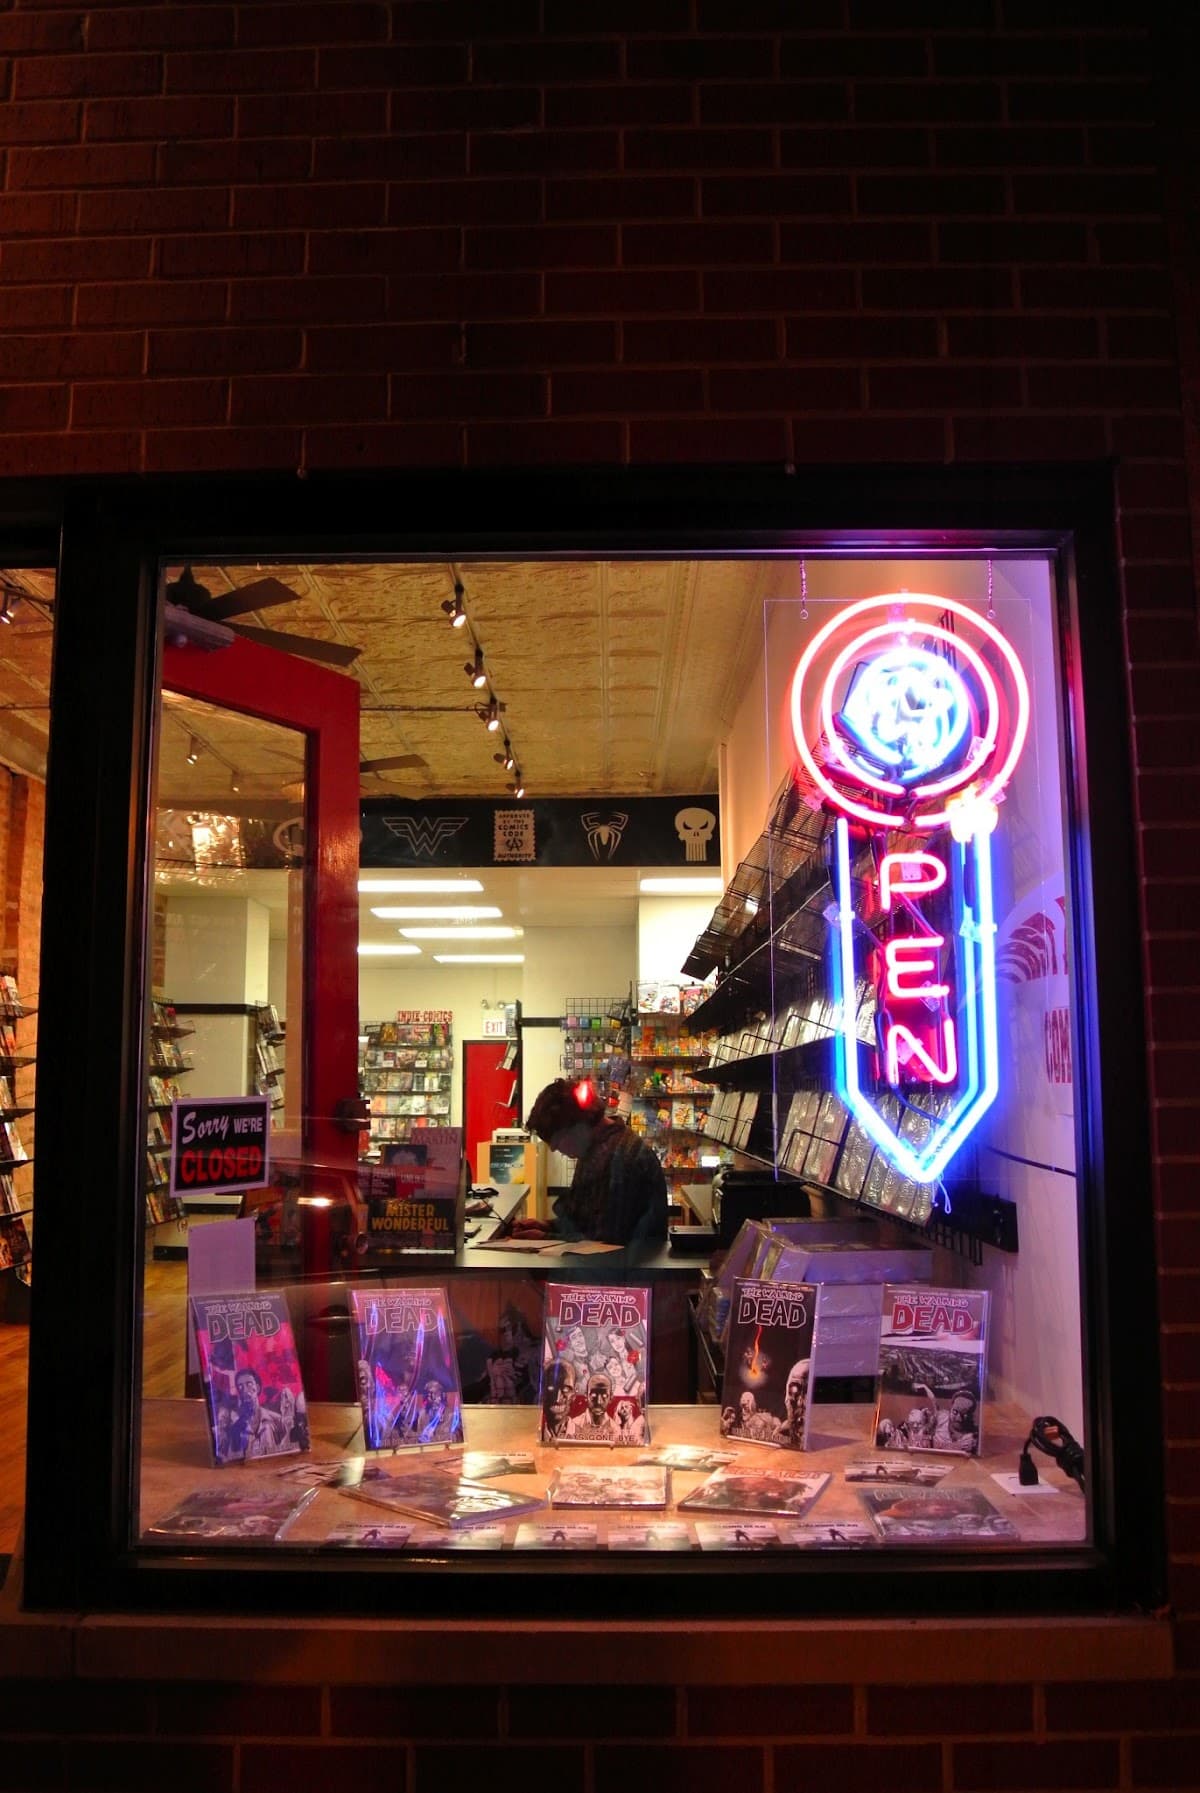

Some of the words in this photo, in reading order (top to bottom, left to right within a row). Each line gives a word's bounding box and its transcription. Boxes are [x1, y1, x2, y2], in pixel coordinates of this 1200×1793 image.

[485, 1020, 504, 1034] EXIT
[182, 1111, 229, 1145] Sorry
[233, 1116, 263, 1134] WE'RE
[181, 1145, 263, 1184] CLOSED
[372, 1217, 448, 1230] WONDERFUL
[386, 1203, 434, 1217] MISTER
[560, 1292, 586, 1302] THE
[586, 1294, 636, 1305] WALKING
[741, 1287, 761, 1298] THE
[762, 1289, 804, 1302] WALKING
[893, 1295, 918, 1305] THE
[920, 1296, 969, 1308] WALKING
[365, 1306, 439, 1334] DEAD
[560, 1300, 640, 1328] DEAD
[738, 1297, 806, 1328] DEAD
[893, 1304, 974, 1334] DEAD
[207, 1311, 280, 1343] DEAD
